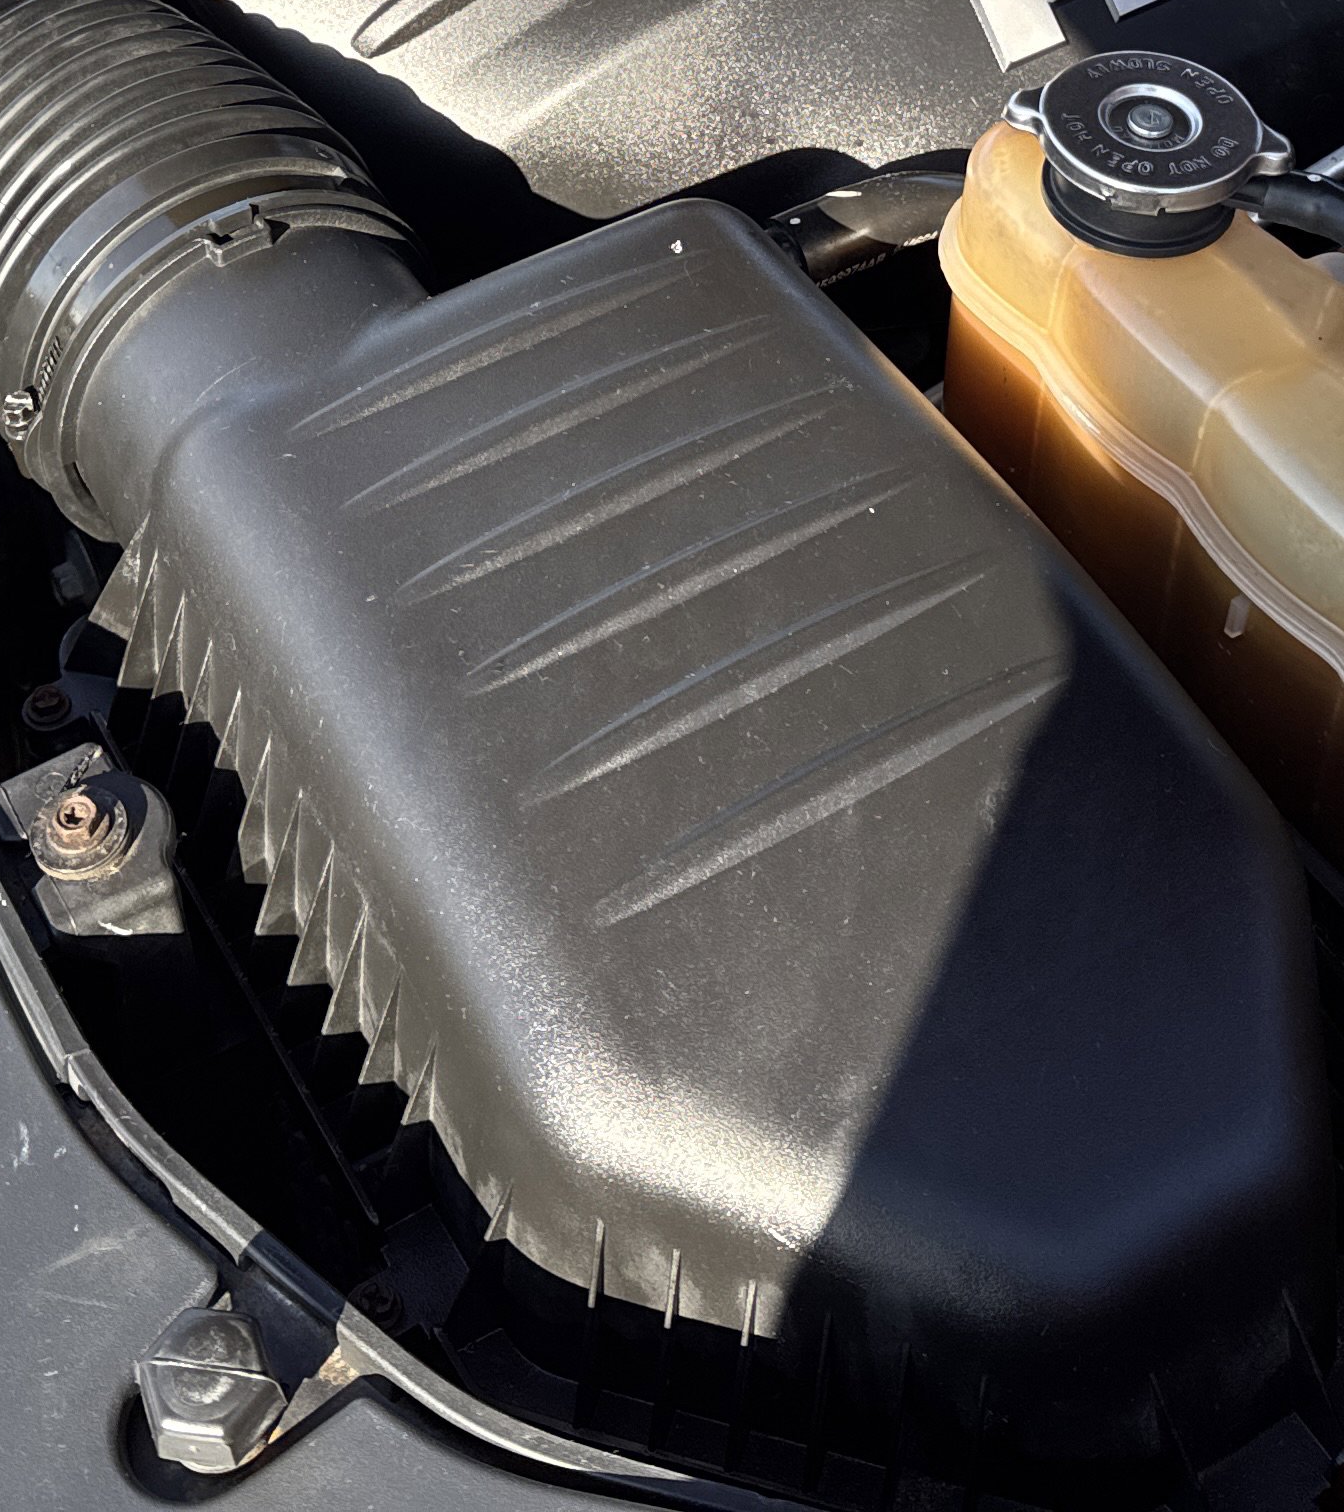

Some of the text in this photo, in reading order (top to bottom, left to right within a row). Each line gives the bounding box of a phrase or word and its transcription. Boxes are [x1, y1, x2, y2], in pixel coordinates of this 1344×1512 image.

[1180, 68, 1234, 105] OPEN
[1091, 144, 1155, 176] OPEN
[1168, 154, 1213, 176] NOT
